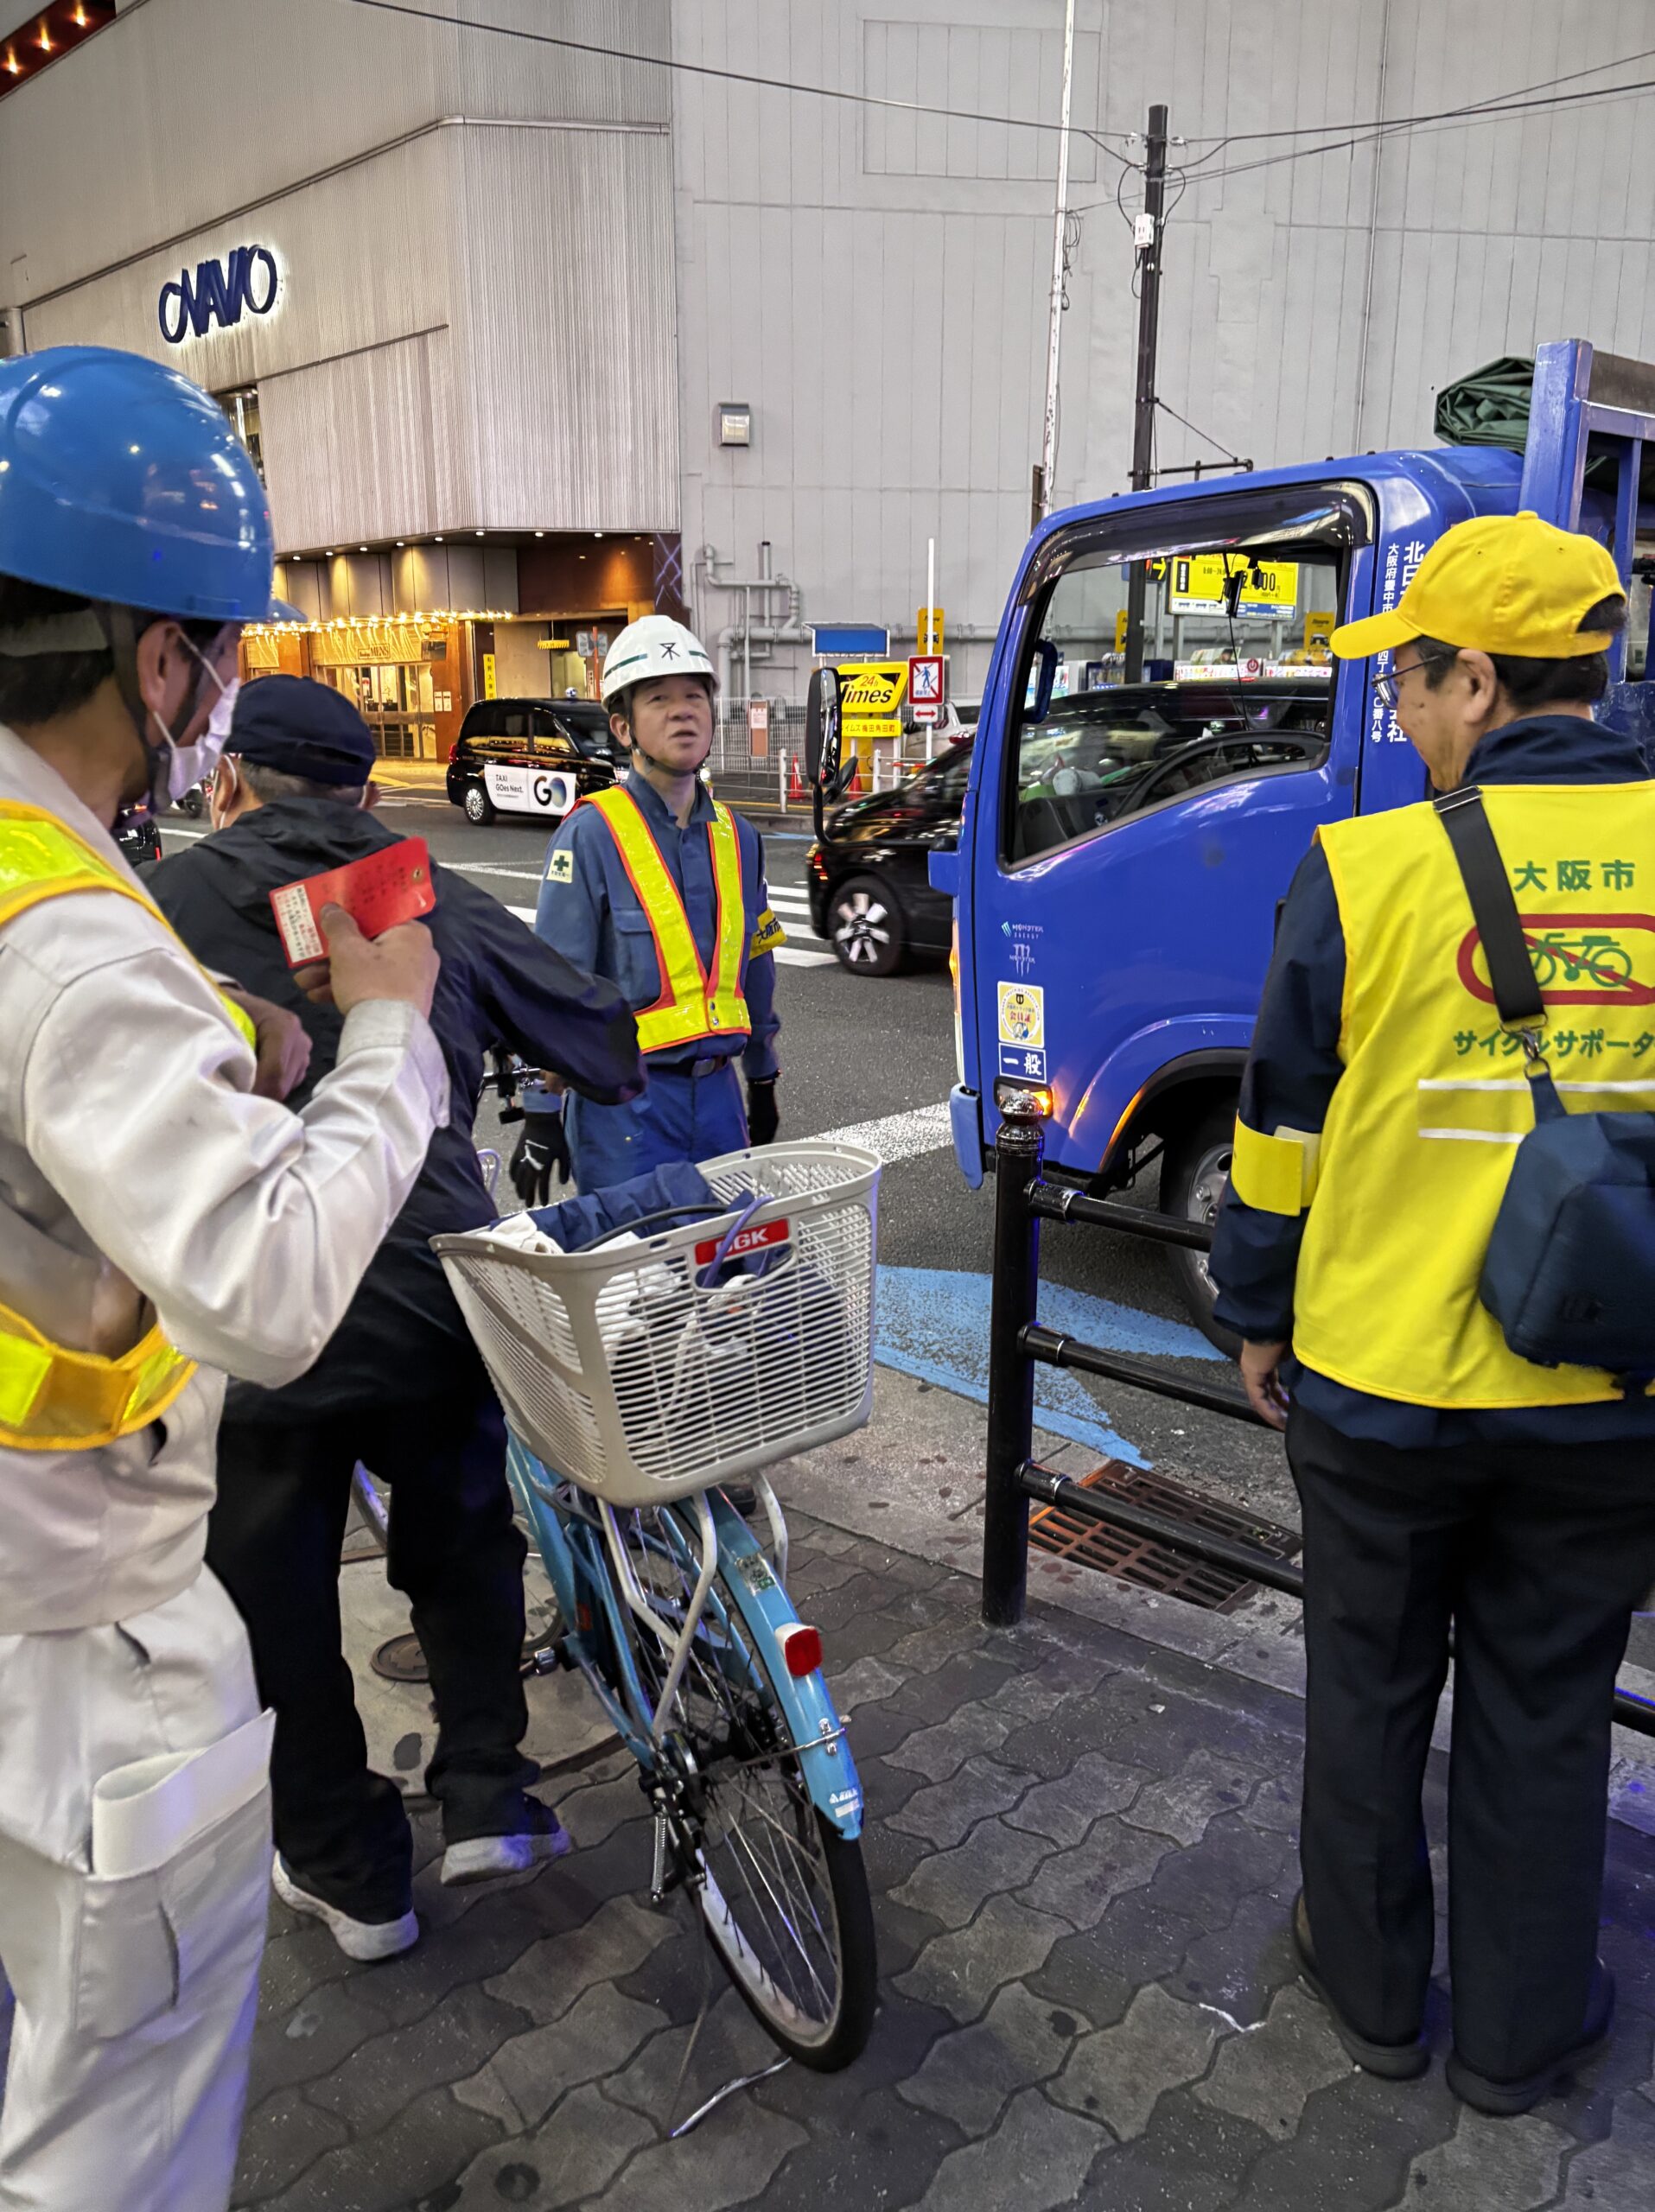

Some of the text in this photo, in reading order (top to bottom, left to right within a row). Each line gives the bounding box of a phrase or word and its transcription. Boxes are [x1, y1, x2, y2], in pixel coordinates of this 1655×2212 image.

[534, 776, 567, 808] GO
[1513, 859, 1635, 892] 大阪市
[1003, 1052, 1042, 1076] 一般
